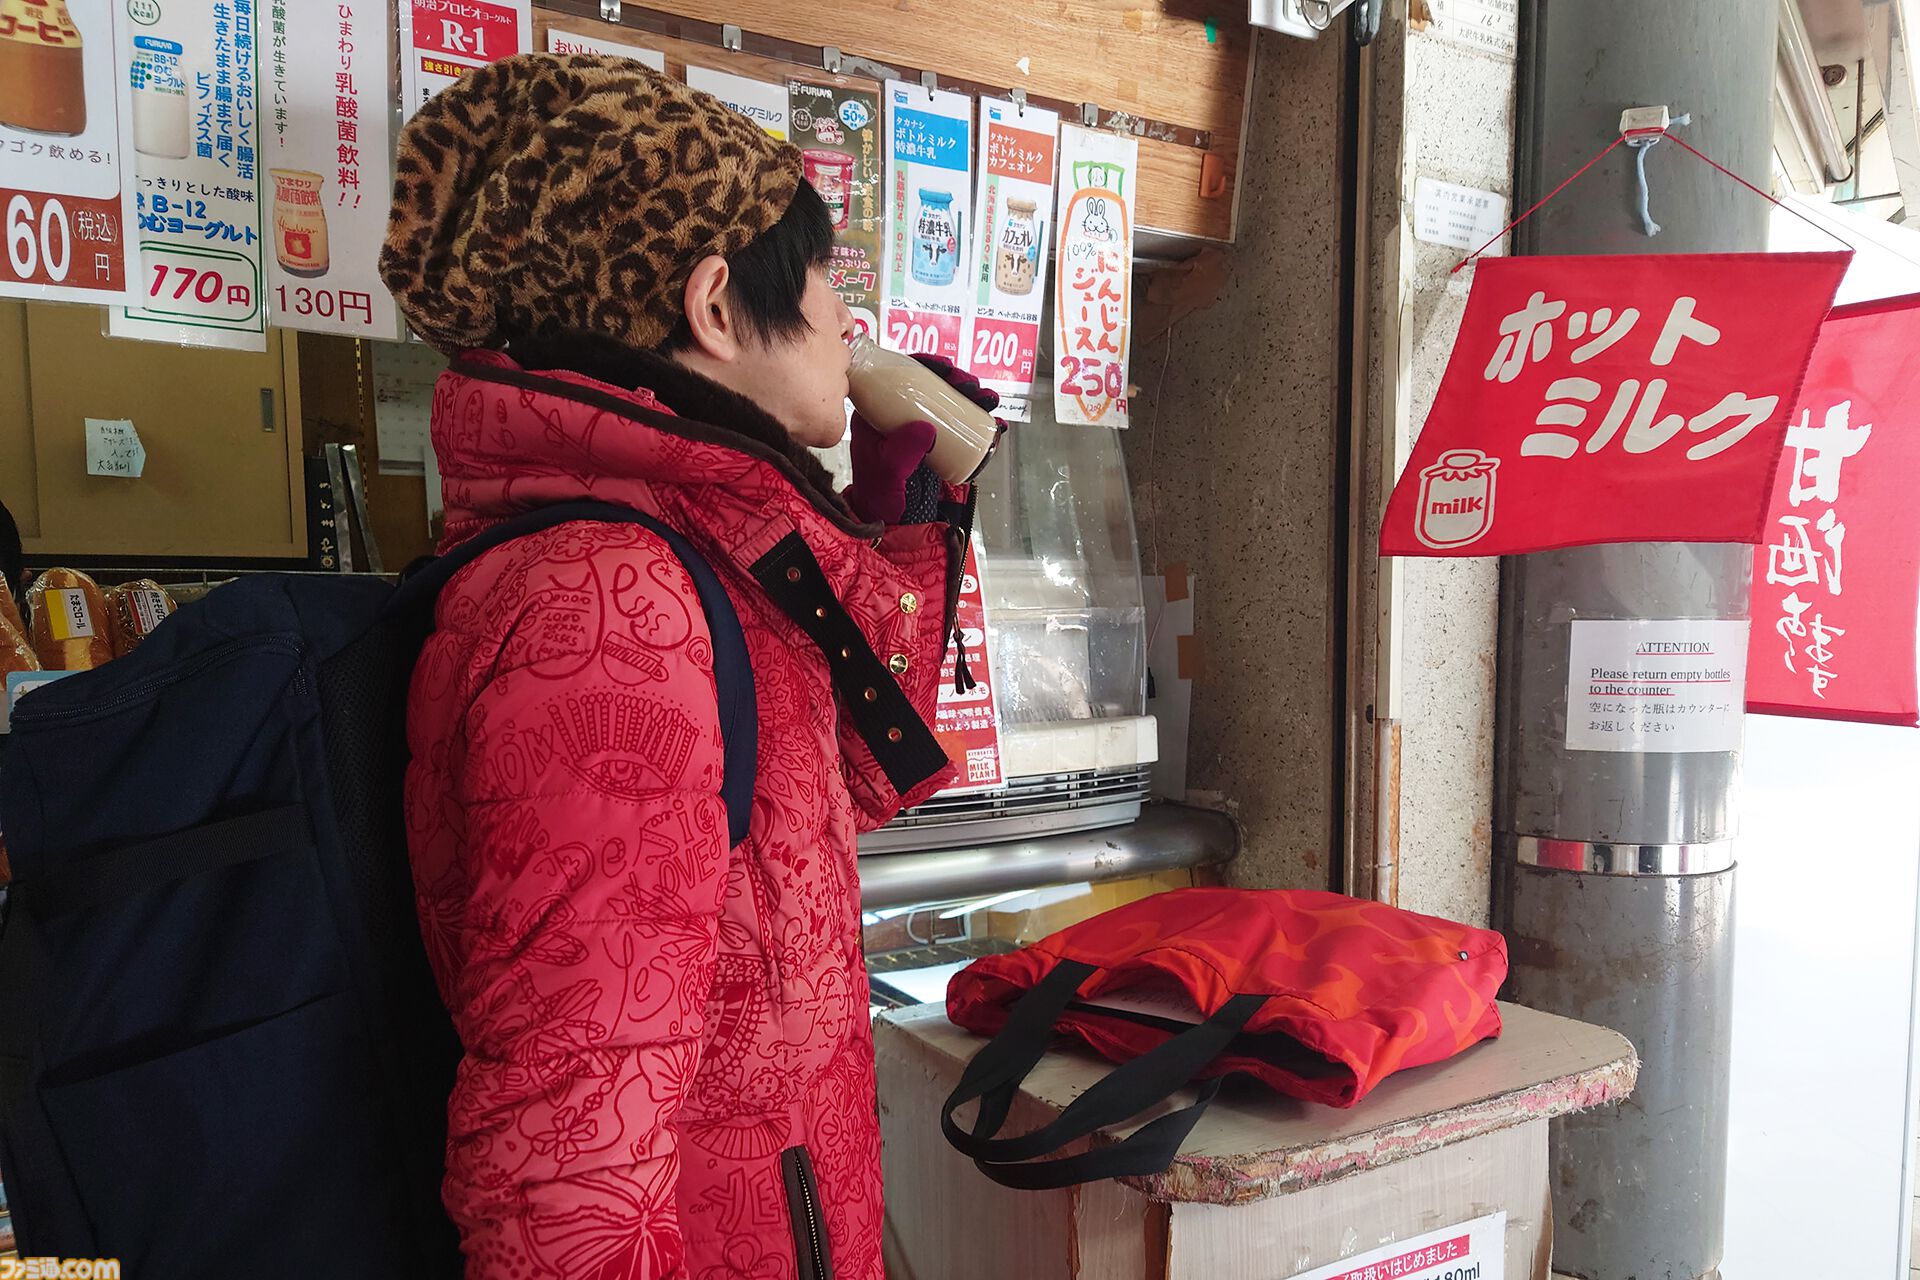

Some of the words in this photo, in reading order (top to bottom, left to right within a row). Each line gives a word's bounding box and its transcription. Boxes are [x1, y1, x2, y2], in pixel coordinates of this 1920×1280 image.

[440, 19, 488, 57] R-1
[154, 65, 172, 77] のむ
[154, 76, 186, 89] ヨーグルト
[213, 3, 234, 168] 生きたまま腸まで届く
[842, 109, 866, 122] 50%
[896, 127, 957, 149] ボトルミルク
[990, 142, 1043, 163] ボトルミルク
[989, 156, 1035, 174] カフェオレ
[135, 175, 255, 203] っきりとした酸味
[1002, 226, 1033, 248] カフェオレ
[1068, 241, 1097, 262] 100%
[94, 252, 110, 281] 円
[275, 284, 373, 325] 130円
[1484, 291, 1720, 384] ホット
[973, 329, 1019, 368] 200
[1021, 361, 1032, 375] 円
[1060, 355, 1122, 399] 250
[1520, 376, 1779, 460] ミルク
[1431, 496, 1483, 515] milk
[70, 594, 87, 630] たまごロール
[1636, 642, 1710, 653] ATTENTION
[1591, 668, 1629, 679] Please
[1632, 669, 1667, 680] return
[1671, 671, 1703, 682] empty
[1705, 668, 1731, 679] bottles
[1590, 684, 1601, 694] to
[1605, 684, 1624, 695] the
[1628, 686, 1671, 696] counter
[1589, 702, 1730, 715] 空になった瓶はカウンターに
[1588, 720, 1675, 733] お返しください
[969, 762, 989, 771] MILK
[970, 770, 995, 780] PLANT
